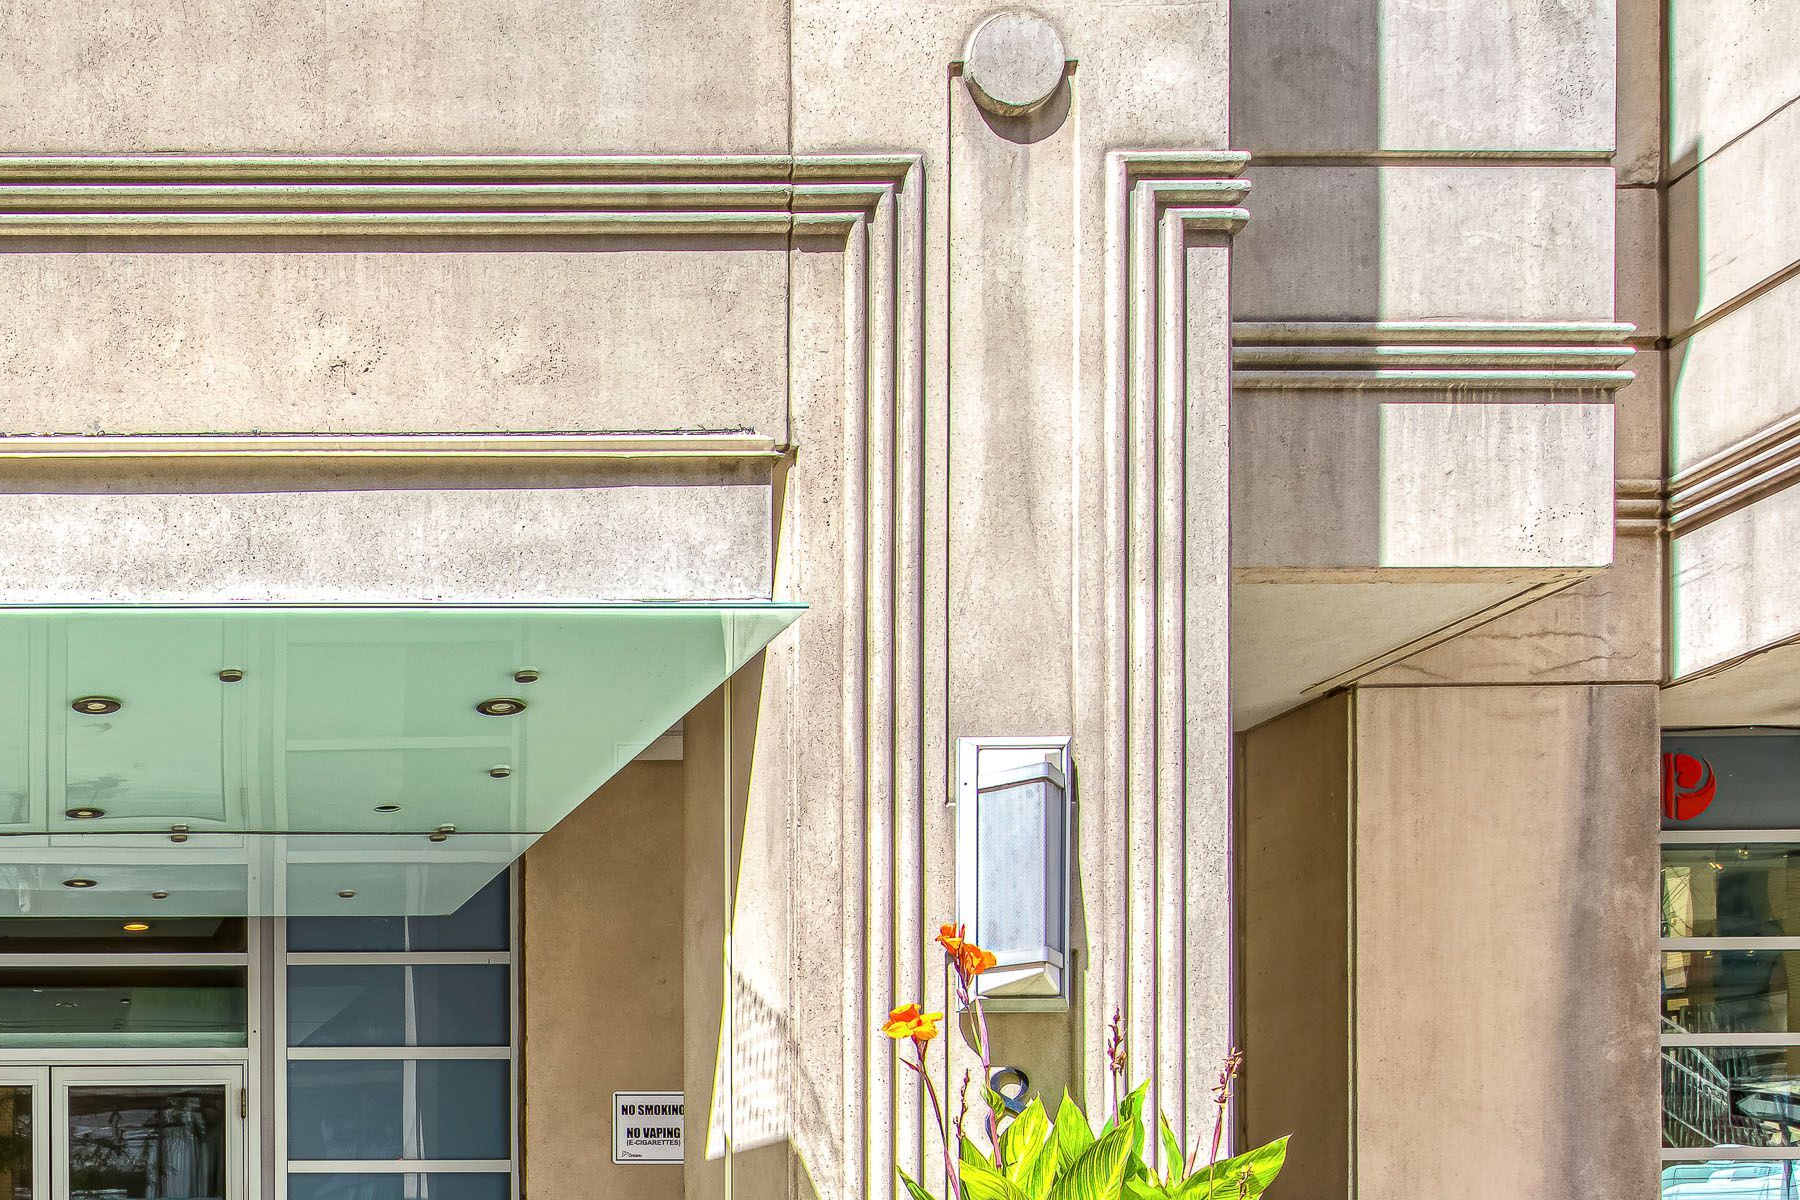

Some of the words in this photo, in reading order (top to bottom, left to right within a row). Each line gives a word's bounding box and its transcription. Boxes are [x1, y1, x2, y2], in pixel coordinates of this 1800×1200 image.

[621, 1104, 635, 1115] NO
[638, 1104, 684, 1115] SMOKING
[626, 1127, 640, 1138] NO
[643, 1127, 680, 1138] VAPING
